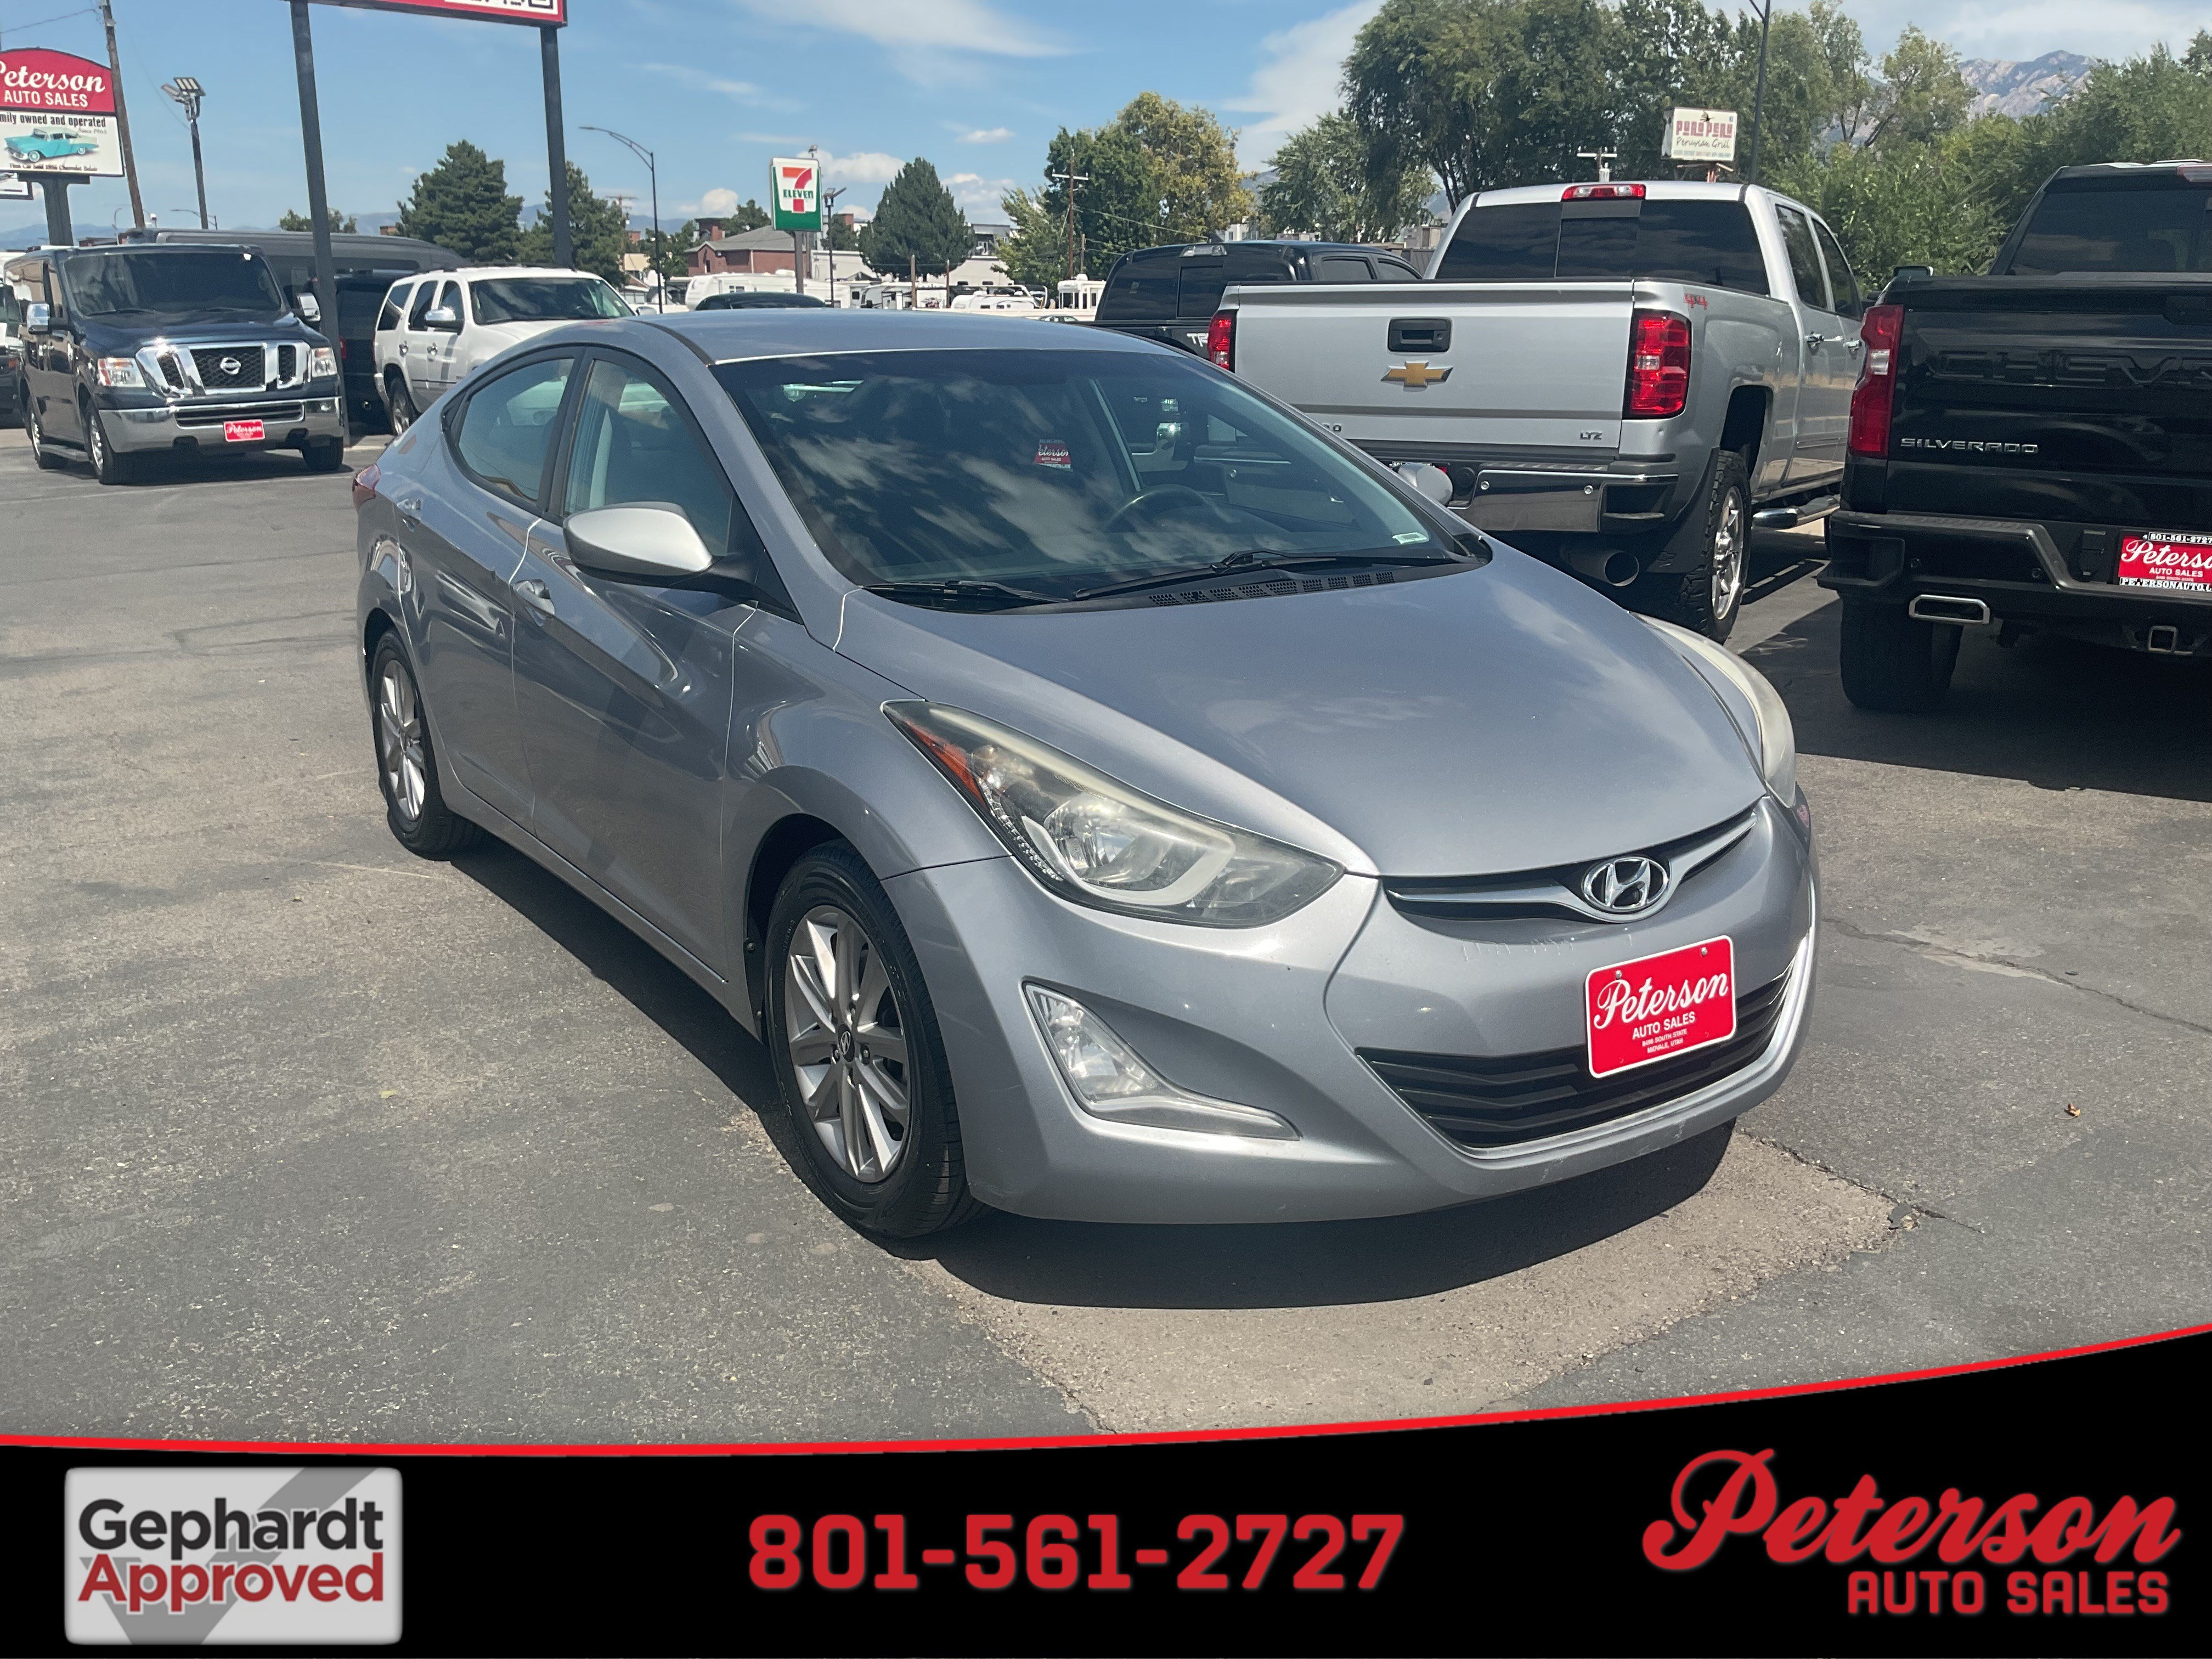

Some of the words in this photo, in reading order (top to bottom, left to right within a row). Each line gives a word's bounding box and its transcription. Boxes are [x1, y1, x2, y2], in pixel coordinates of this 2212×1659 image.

[4, 90, 41, 104] AUTO
[45, 92, 88, 108] SALES
[20, 114, 47, 124] owned
[50, 115, 65, 125] and
[69, 116, 106, 127] operated
[1705, 122, 1733, 138] PERU
[1676, 137, 1710, 148] Peruvian
[1712, 139, 1730, 149] Grill
[782, 167, 812, 212] 7
[1580, 431, 1602, 440] LTZ
[1900, 438, 2039, 453] SILVERADO
[2150, 533, 2212, 544] 801-561-2727
[2175, 569, 2203, 578] SALES
[1594, 973, 1729, 1029] Peterson
[1632, 1022, 1661, 1040] AUTO
[1663, 1011, 1696, 1030] SALES
[1655, 1033, 1672, 1043] SOUTH
[1673, 1029, 1688, 1037] STATE
[1671, 1037, 1684, 1046] UTAH
